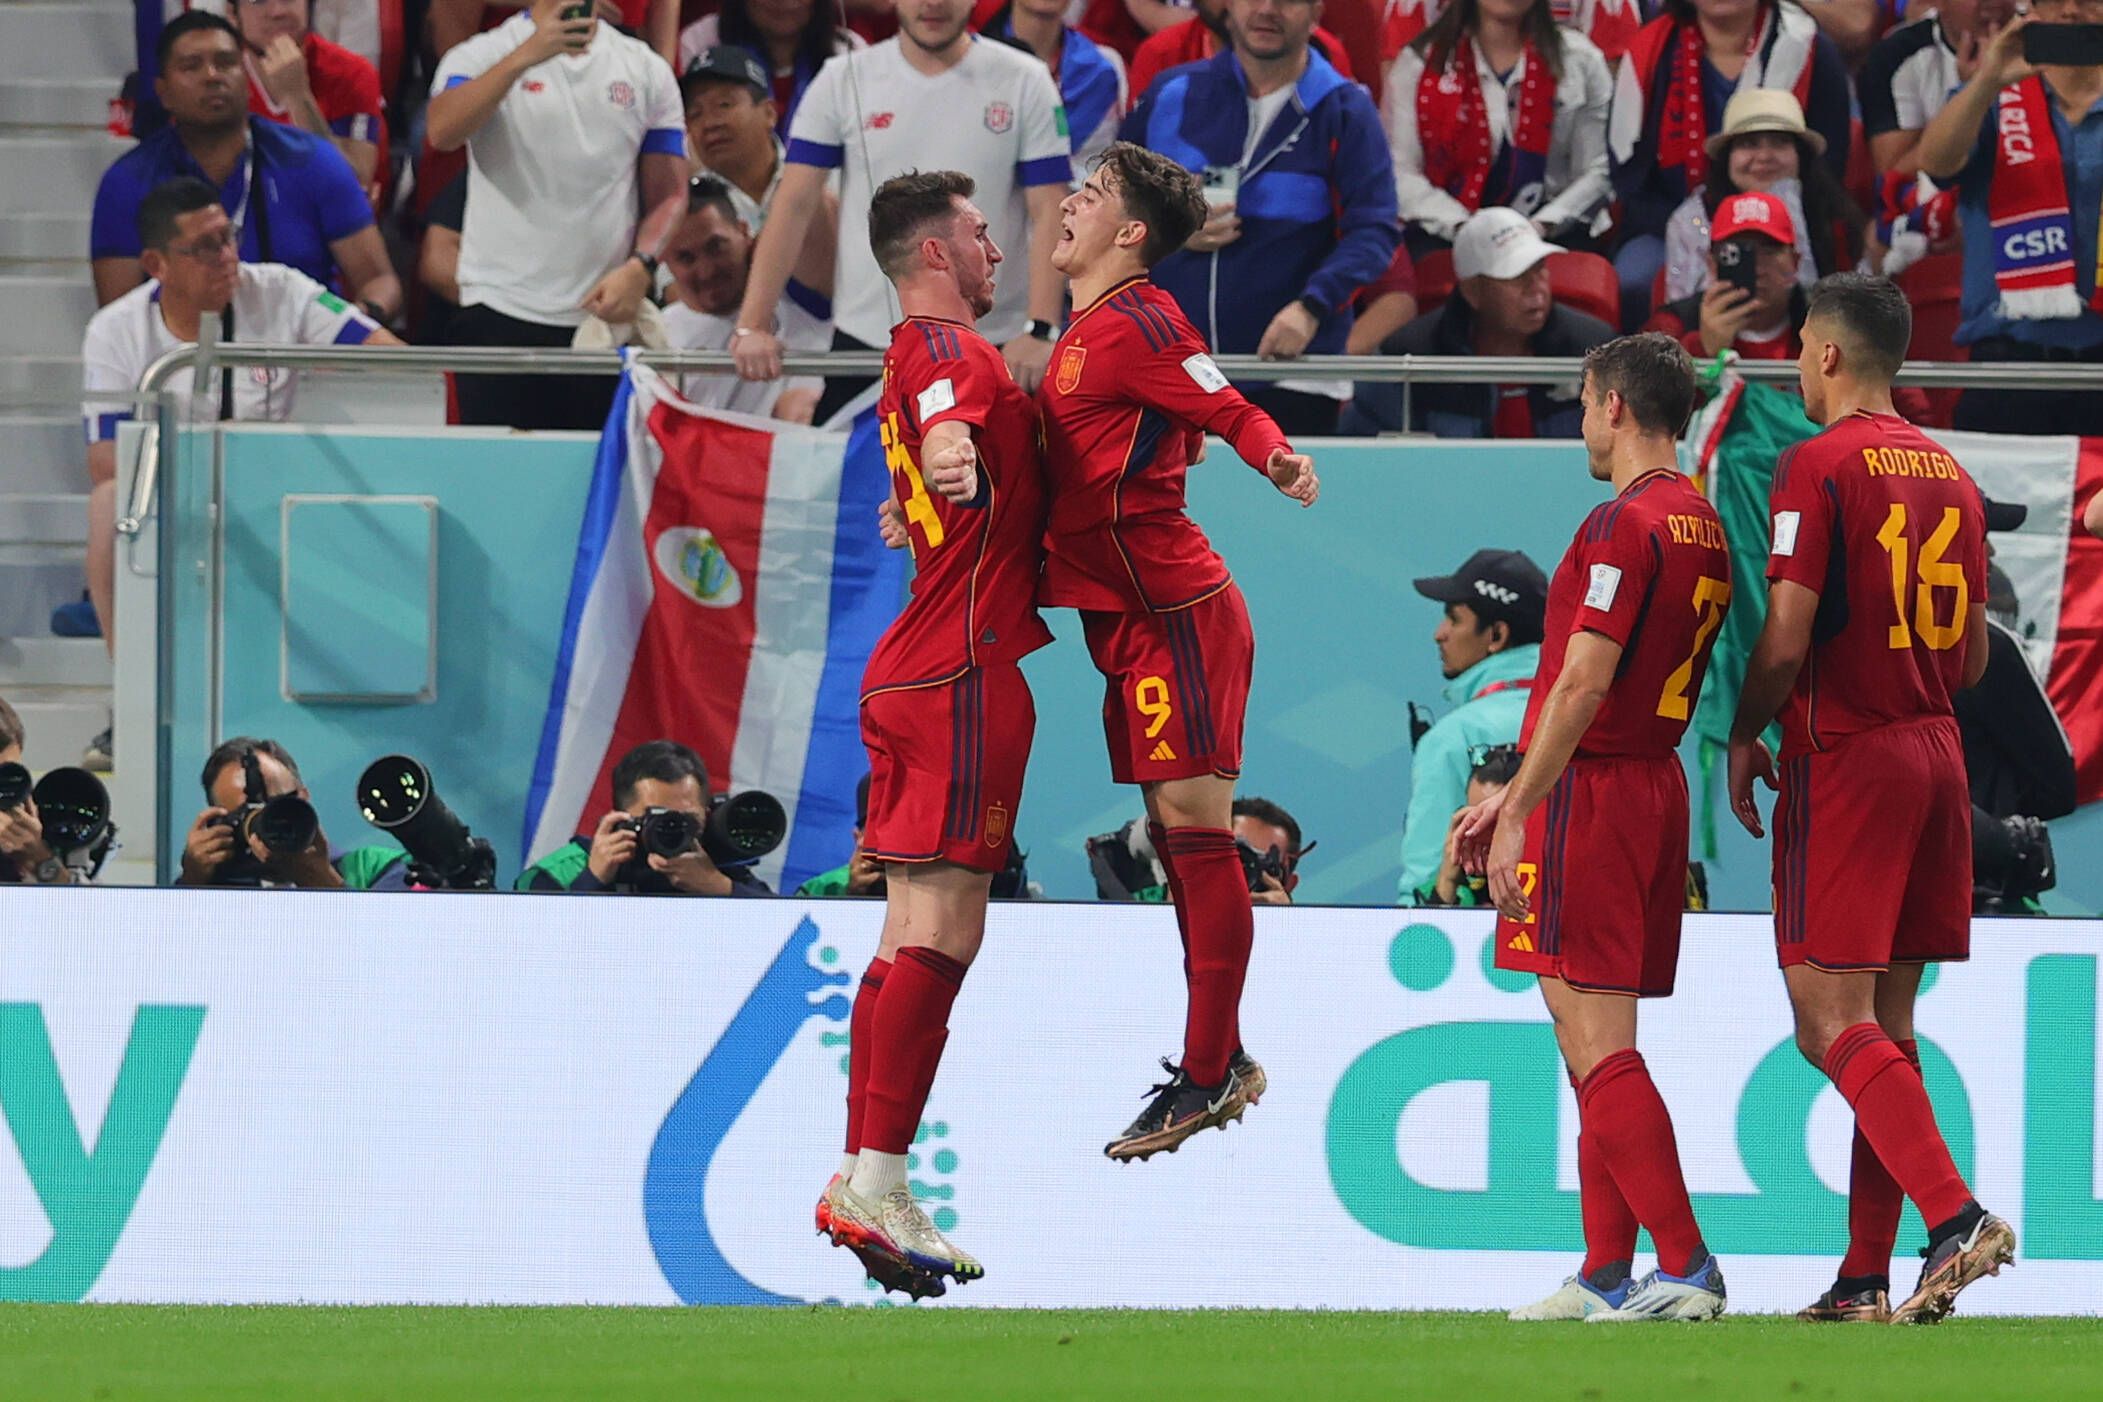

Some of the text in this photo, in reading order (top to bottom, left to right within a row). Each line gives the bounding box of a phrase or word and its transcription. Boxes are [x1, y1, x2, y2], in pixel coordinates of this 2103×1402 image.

[1999, 107, 2035, 166] RICA
[2004, 226, 2068, 260] CSR
[1862, 448, 1960, 481] RODRIGO
[1875, 503, 1968, 650] 16
[1656, 575, 1731, 721] 2
[1135, 676, 1172, 738] 9
